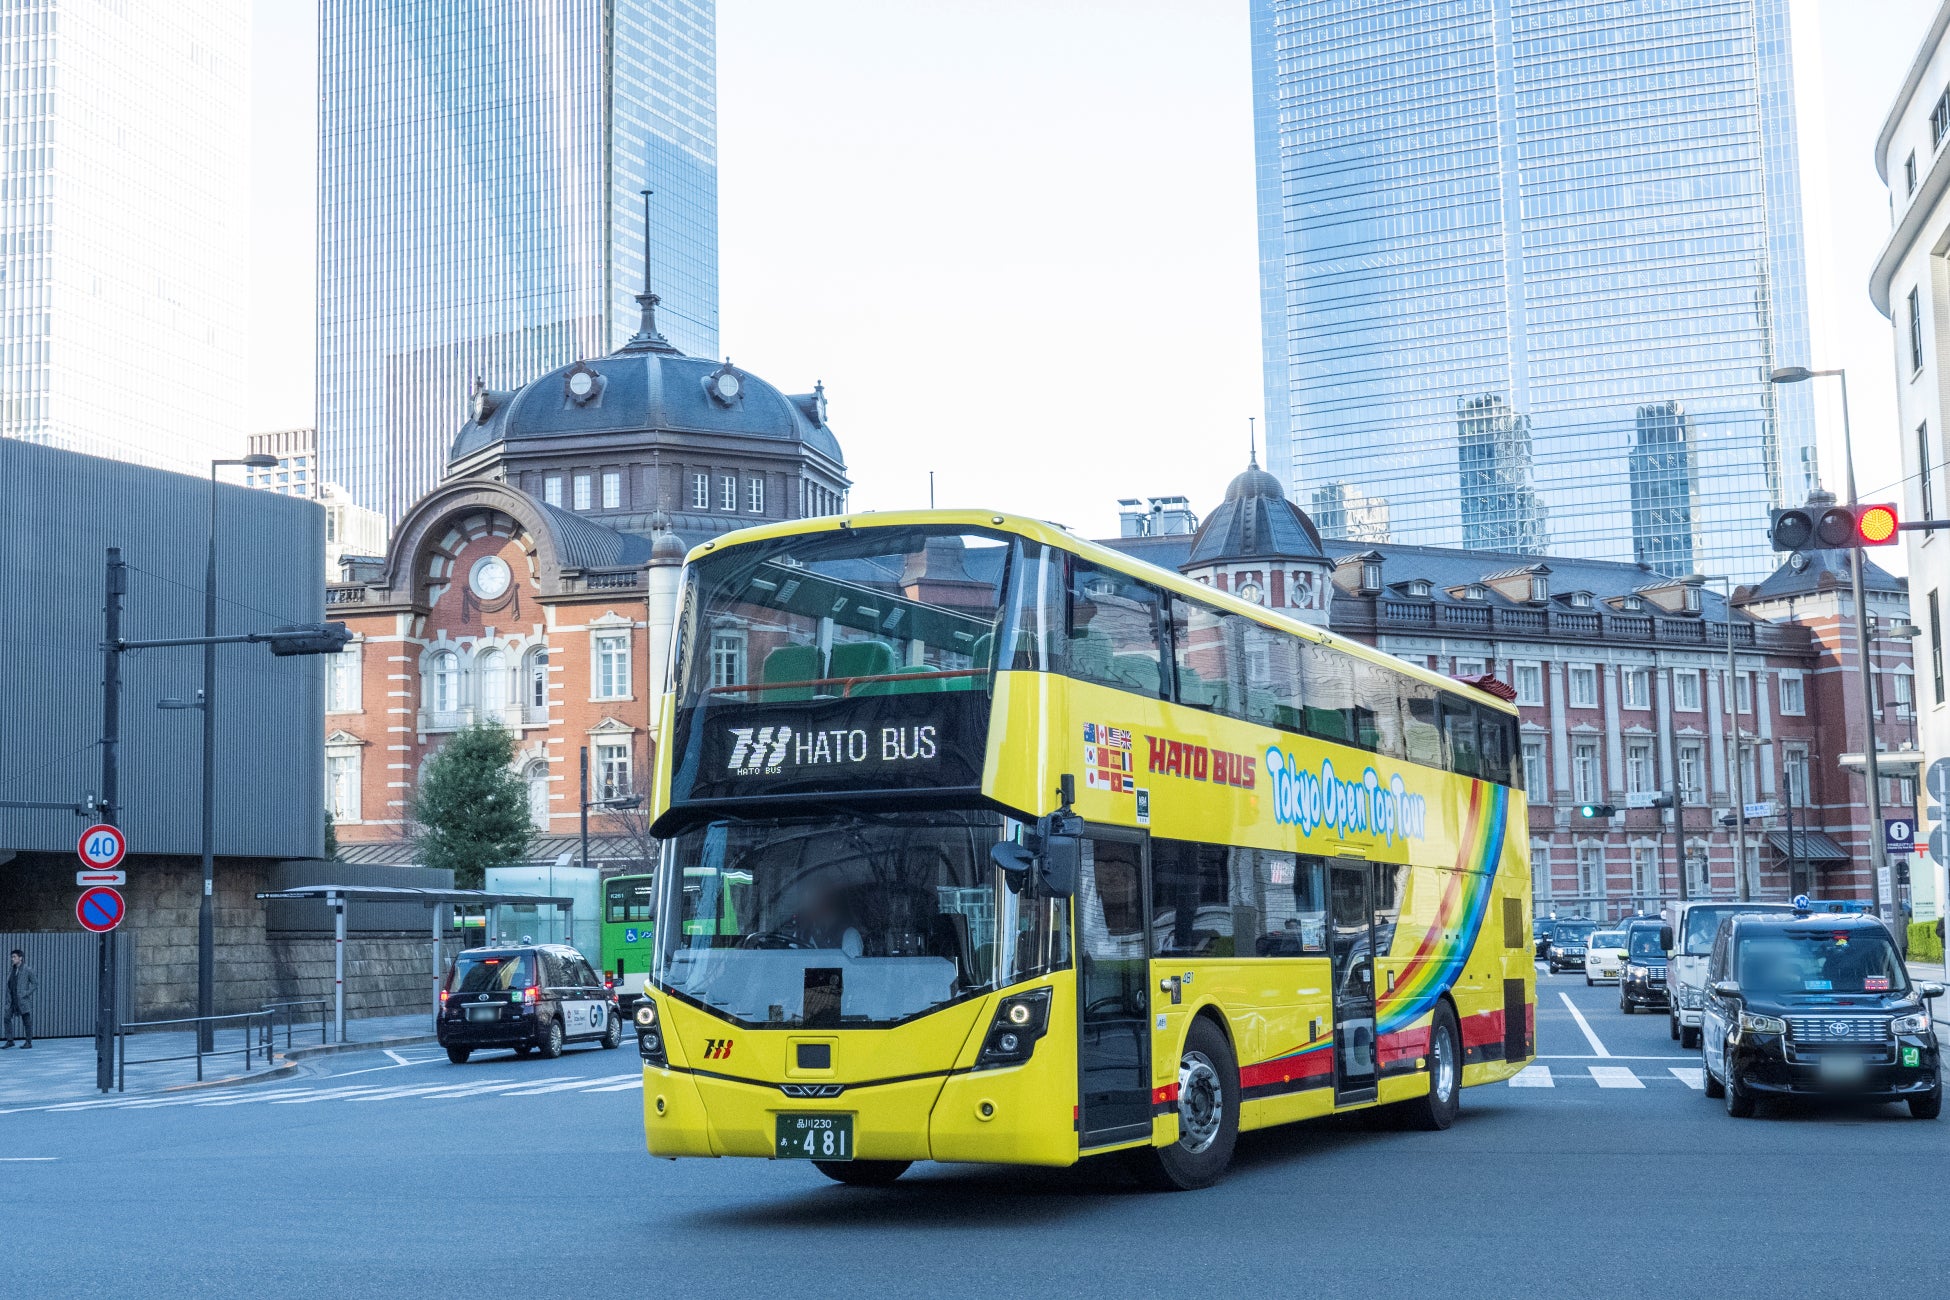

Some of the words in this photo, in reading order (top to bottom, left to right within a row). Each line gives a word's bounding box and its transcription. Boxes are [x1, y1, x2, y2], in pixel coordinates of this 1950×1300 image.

[795, 729, 867, 765] HATO
[882, 726, 936, 760] BUS
[737, 768, 760, 776] HATO
[765, 766, 781, 775] BUS
[1145, 735, 1208, 782] HATO
[1210, 749, 1256, 790] BUS
[1266, 746, 1321, 838] Tokyo
[1321, 758, 1367, 840] Open
[1363, 766, 1394, 848] Top
[1390, 773, 1425, 842] Tour
[89, 837, 115, 857] 40
[796, 1118, 832, 1129] 品川230
